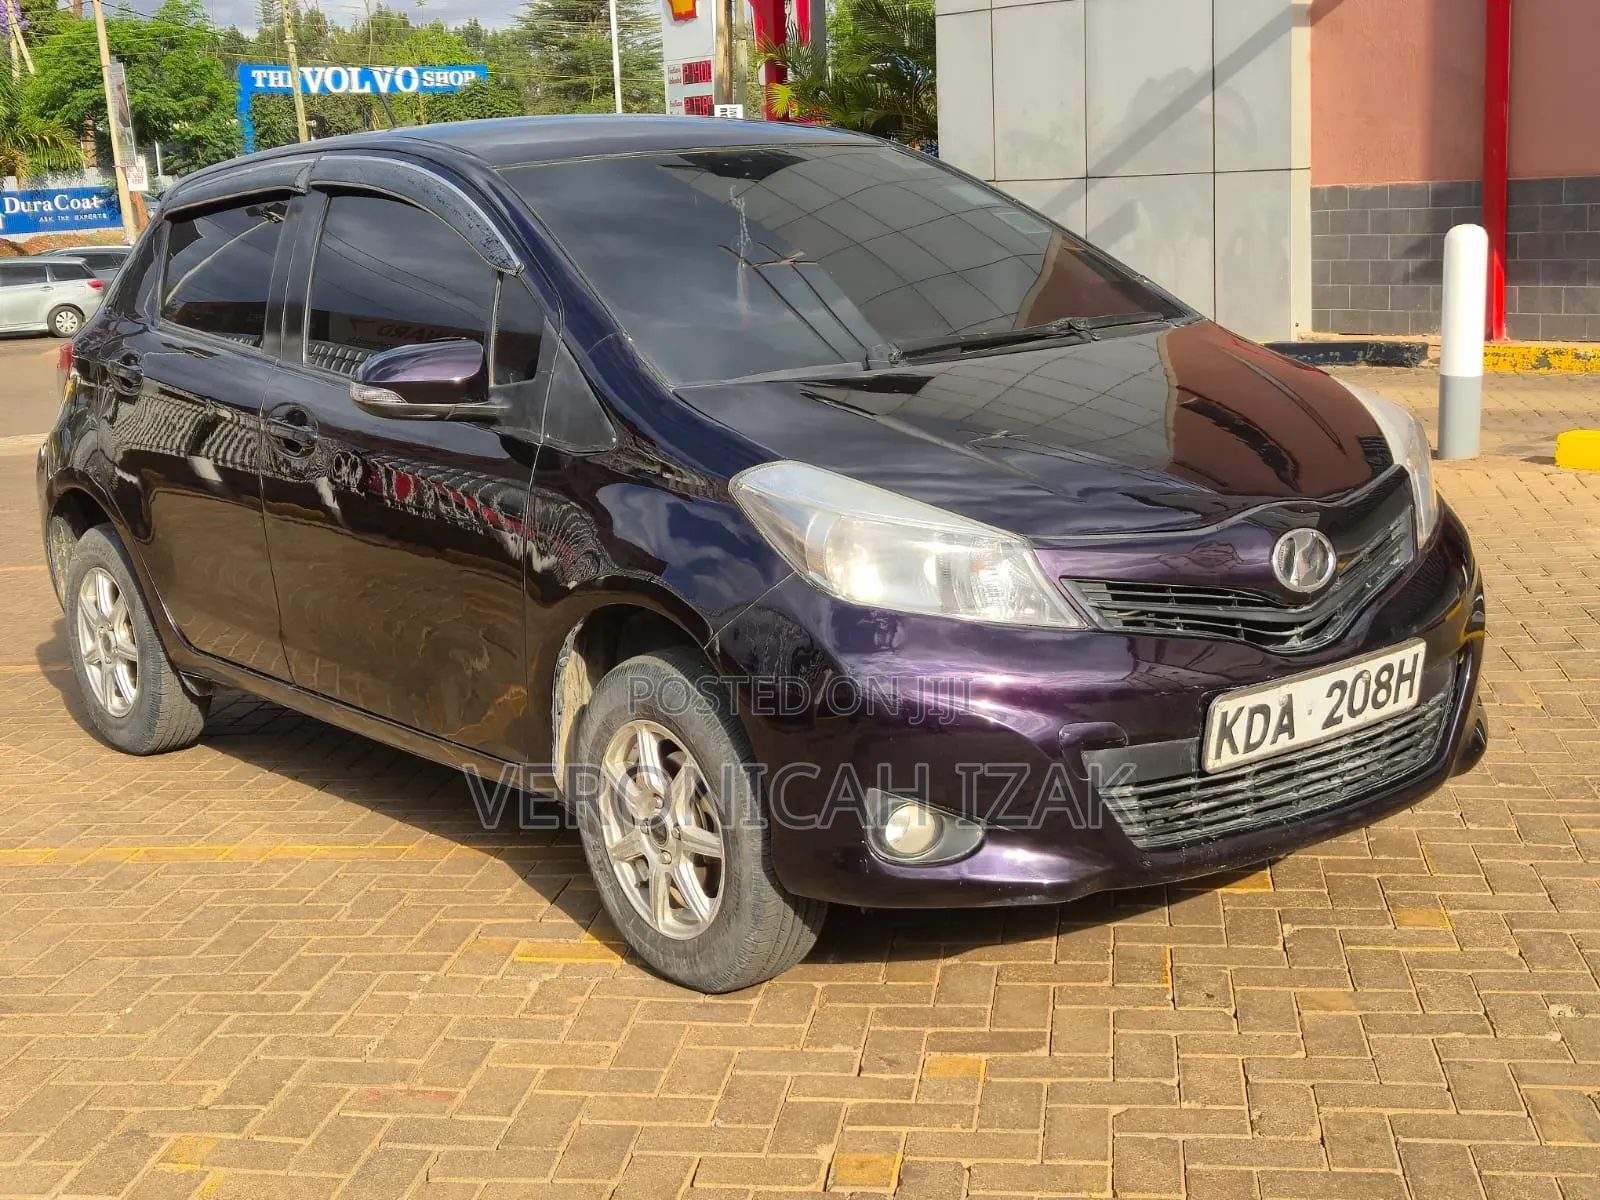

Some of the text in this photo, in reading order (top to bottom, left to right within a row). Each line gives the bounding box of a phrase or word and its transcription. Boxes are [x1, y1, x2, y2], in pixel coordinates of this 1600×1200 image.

[299, 66, 419, 93] VOLVO
[423, 70, 476, 87] SHOP
[3, 194, 100, 213] DuraCoat
[1214, 653, 1419, 760] KDA 208H
